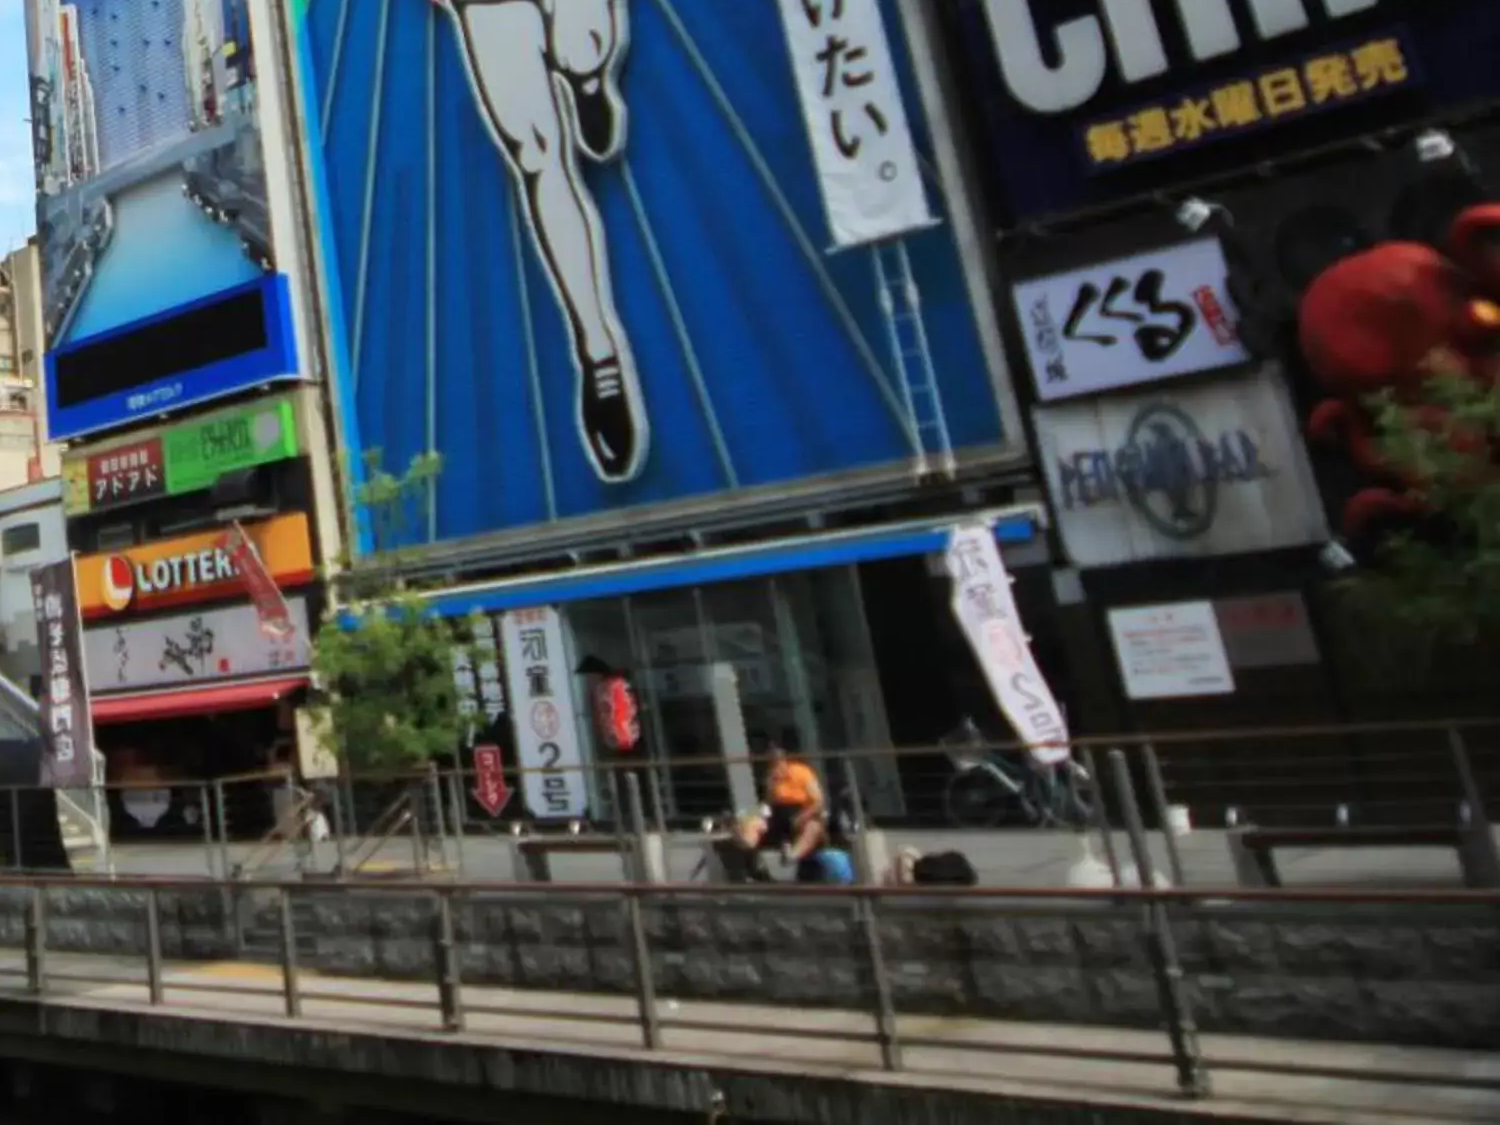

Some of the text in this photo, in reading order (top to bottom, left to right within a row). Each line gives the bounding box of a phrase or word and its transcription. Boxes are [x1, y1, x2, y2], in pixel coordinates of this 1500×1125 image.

[1084, 38, 1409, 164] 毎週水曜日発売
[1062, 268, 1196, 363] くくる
[136, 547, 241, 593] LOTTER
